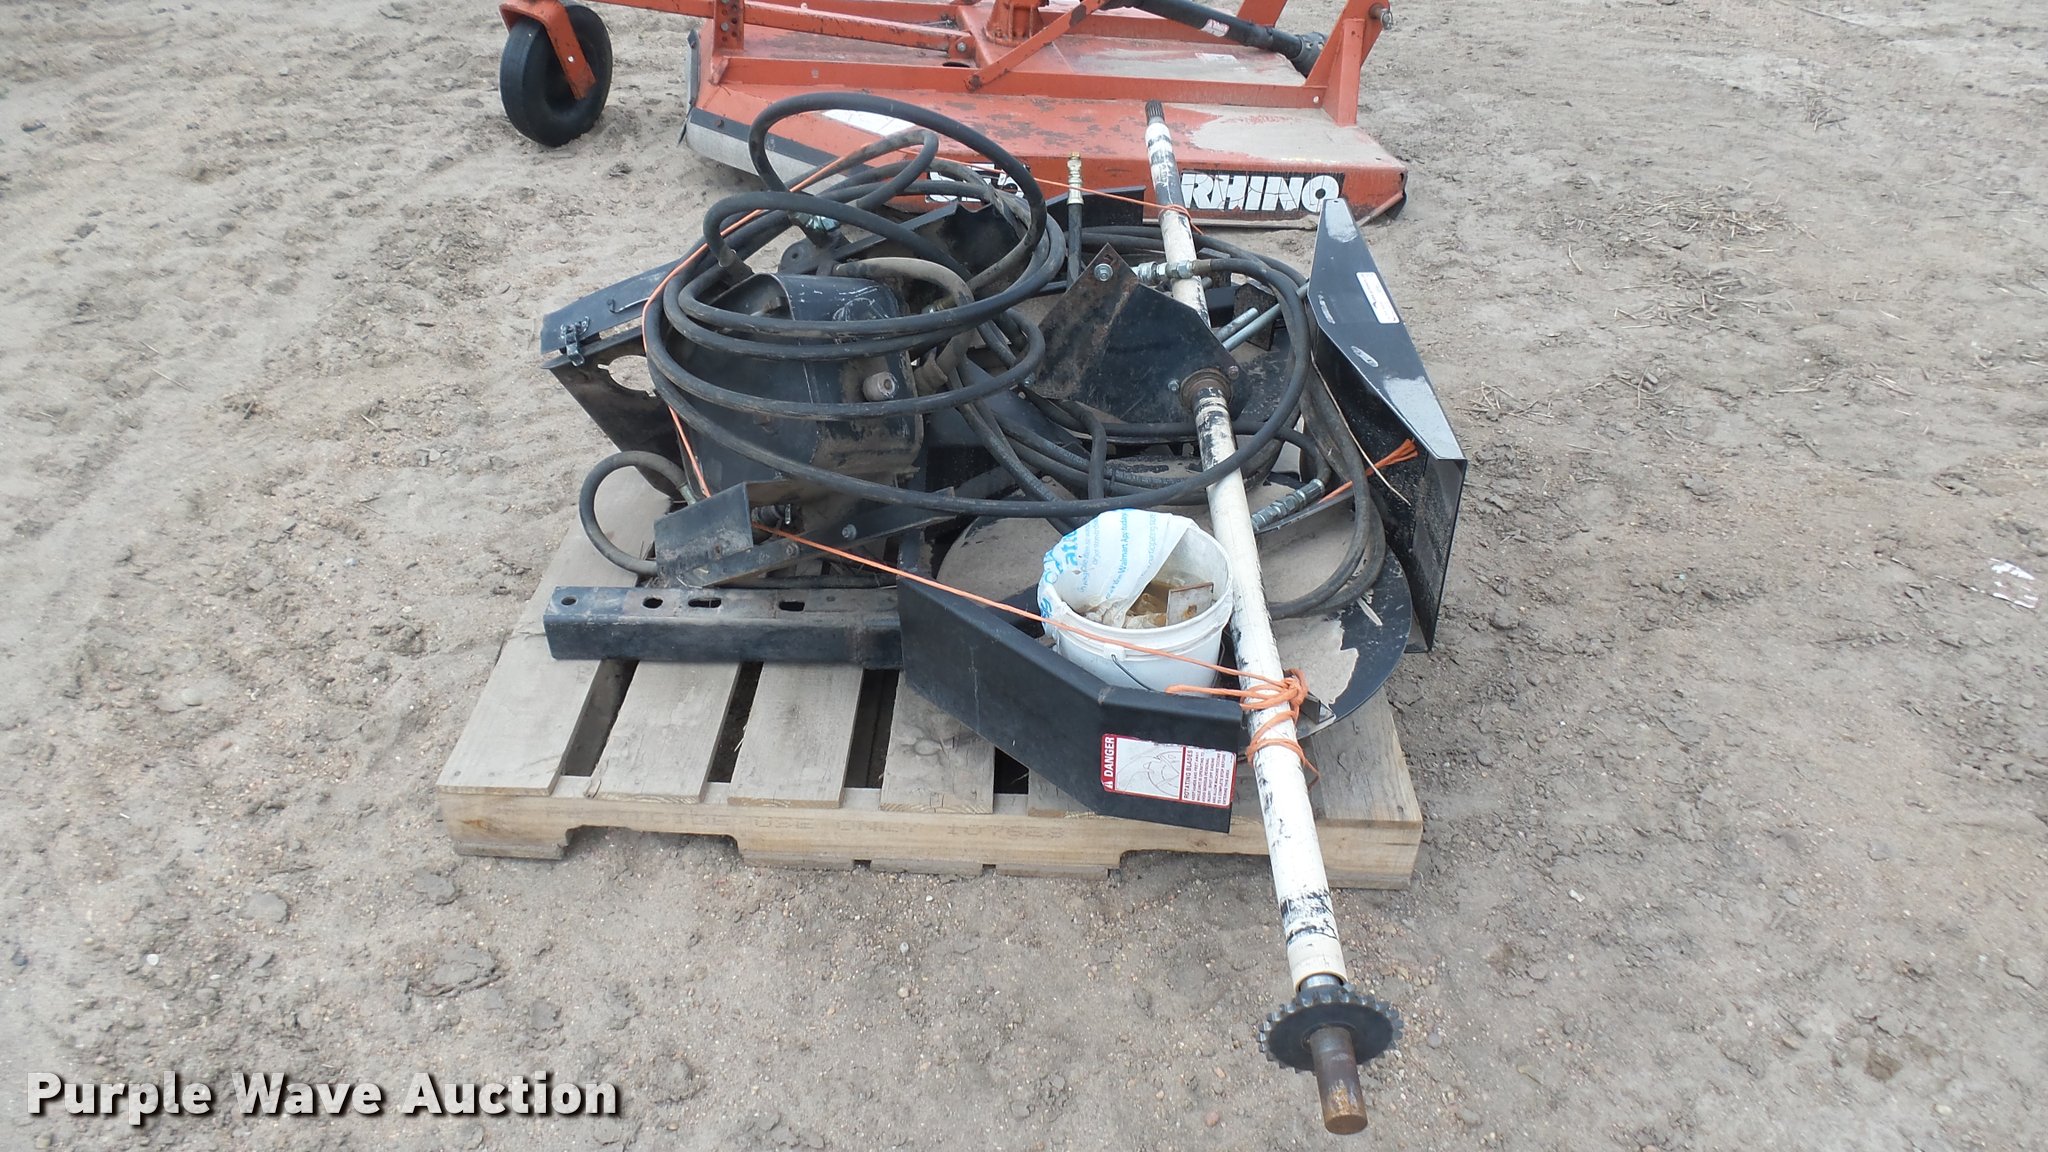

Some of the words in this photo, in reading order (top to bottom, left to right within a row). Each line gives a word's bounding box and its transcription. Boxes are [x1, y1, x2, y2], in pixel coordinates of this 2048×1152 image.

[1181, 172, 1340, 213] RHINO
[1104, 737, 1115, 777] DANGER
[1183, 772, 1191, 799] ROTATING
